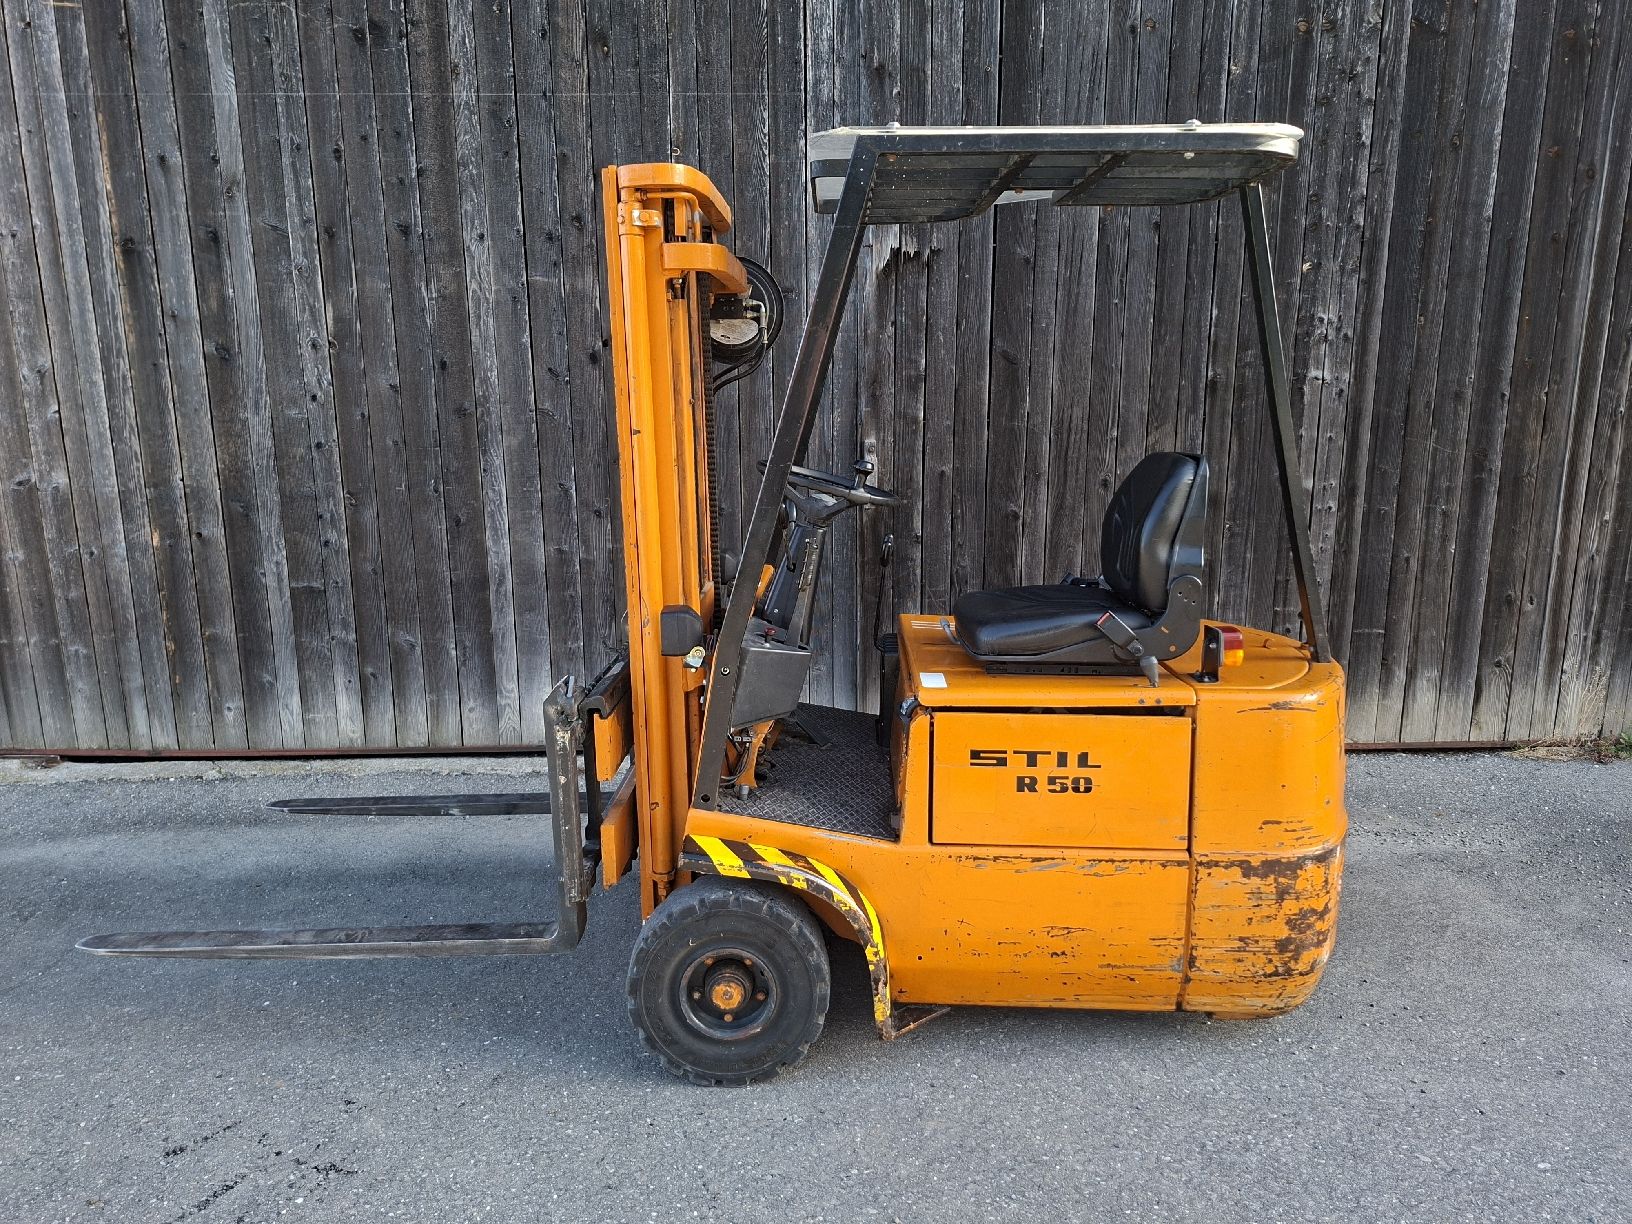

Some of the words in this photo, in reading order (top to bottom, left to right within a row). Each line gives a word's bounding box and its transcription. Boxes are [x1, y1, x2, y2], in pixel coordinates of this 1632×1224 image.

[969, 749, 1102, 769] STIL
[1016, 775, 1038, 793] R
[1047, 775, 1093, 794] 50
